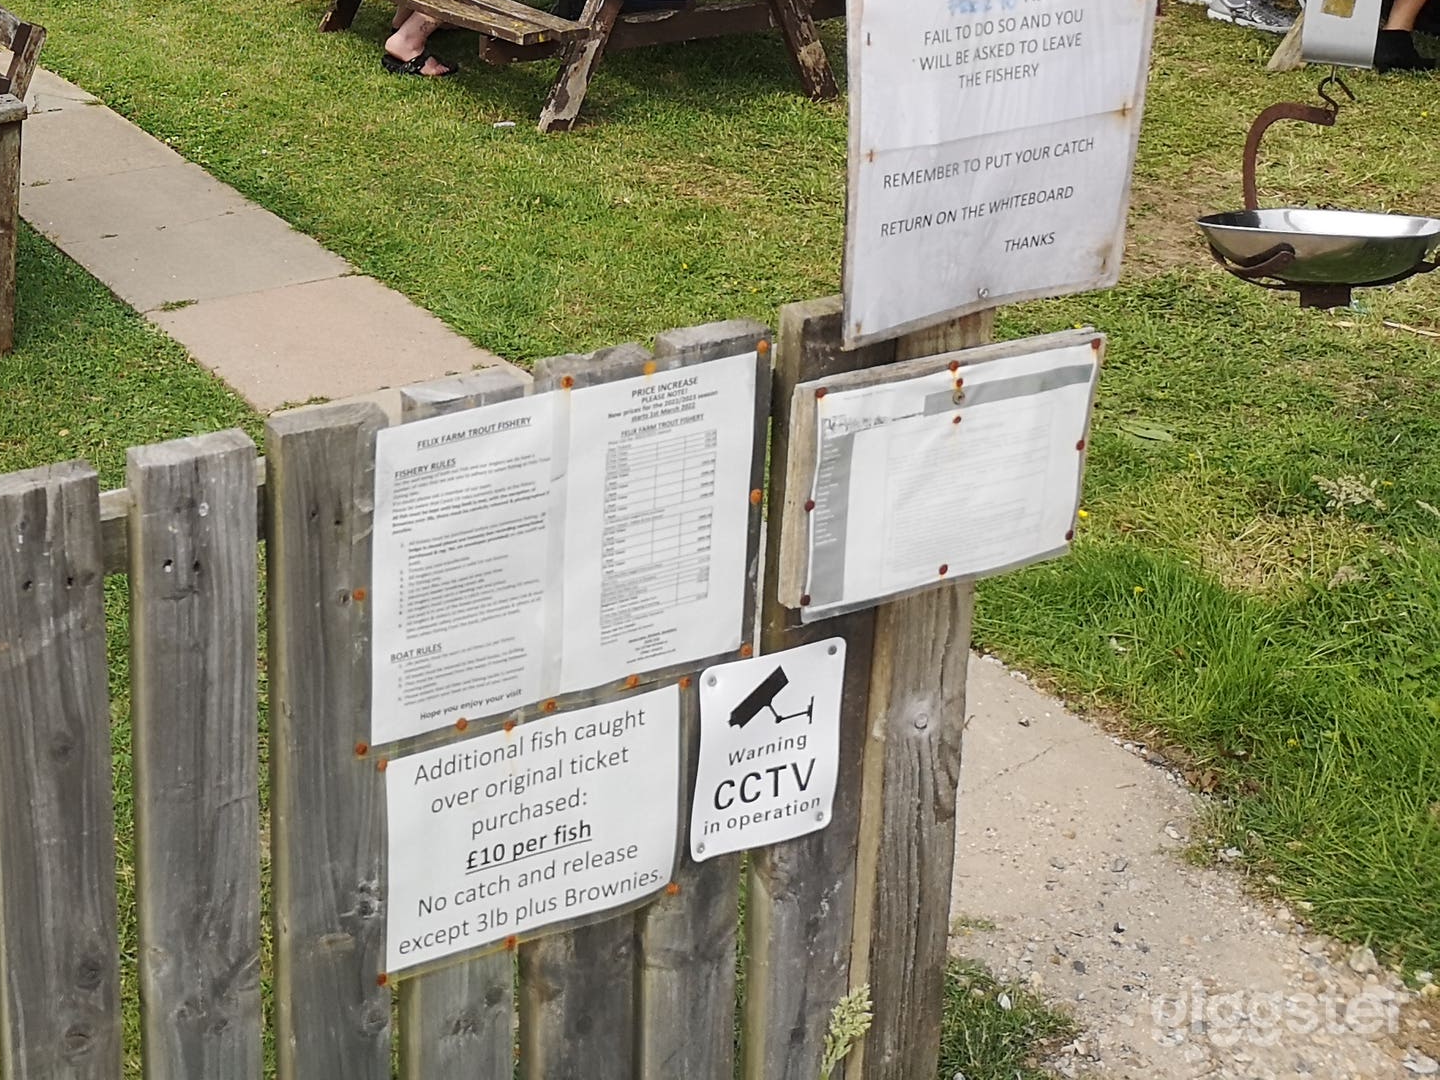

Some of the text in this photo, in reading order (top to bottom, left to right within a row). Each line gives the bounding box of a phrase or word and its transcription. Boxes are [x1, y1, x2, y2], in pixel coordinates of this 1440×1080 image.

[924, 9, 1084, 46] FAIL TO DO SO AND YOU
[920, 33, 1082, 71] WILL BE ASKED TO LEAVE
[959, 63, 1040, 88] THE FISHERY
[883, 137, 1094, 189] REMEMBER TO PUT YOUR CATCH
[881, 186, 1074, 237] RETURN ON THE WHITEBOARD
[1004, 232, 1056, 253] THANKS
[631, 377, 698, 398] PRICE INCREASE
[641, 392, 665, 403] PLEASE
[417, 417, 532, 449] FELIX FARM TROUT FISHERY
[394, 464, 428, 479] FISHERY
[430, 458, 457, 470] RULES
[390, 649, 414, 662] BOAT
[416, 643, 442, 656] RULES
[420, 689, 522, 720] Hope you enjoy your visit
[414, 709, 646, 786] Additional fish caught
[728, 735, 807, 766] Warning
[431, 746, 630, 814] over original ticket
[714, 758, 816, 810] CCTV
[471, 788, 588, 840] purchased:
[704, 797, 821, 835] in operation
[466, 820, 592, 870] £10 per fish
[417, 844, 639, 917] No catch and release
[398, 868, 664, 955] except 3lb plus Brownies.
